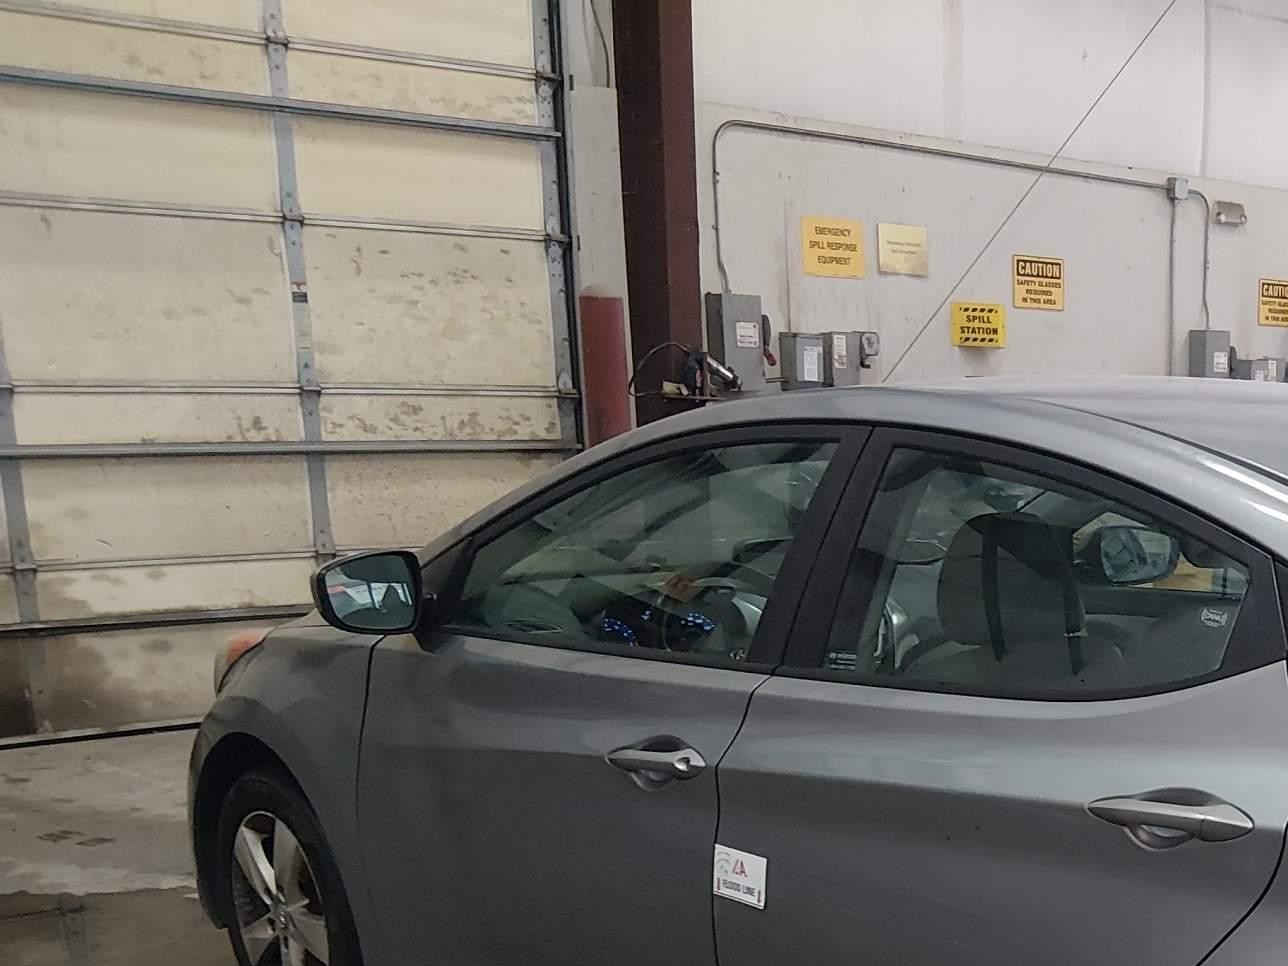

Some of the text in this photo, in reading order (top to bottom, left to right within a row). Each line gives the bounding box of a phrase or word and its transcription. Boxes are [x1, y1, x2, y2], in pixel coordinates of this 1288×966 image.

[814, 225, 851, 237] EMERGENCY
[809, 239, 858, 252] SPILL RESPONSE
[817, 255, 851, 266] EQUIPMENT
[1018, 261, 1060, 278] CAUTION
[1017, 279, 1062, 289] SAFETY GLASSES
[1025, 288, 1053, 297] REQUIRED
[1029, 297, 1042, 305] THIS
[1042, 298, 1057, 306] AREA
[965, 314, 993, 324] SPILL
[960, 326, 999, 336] STATION
